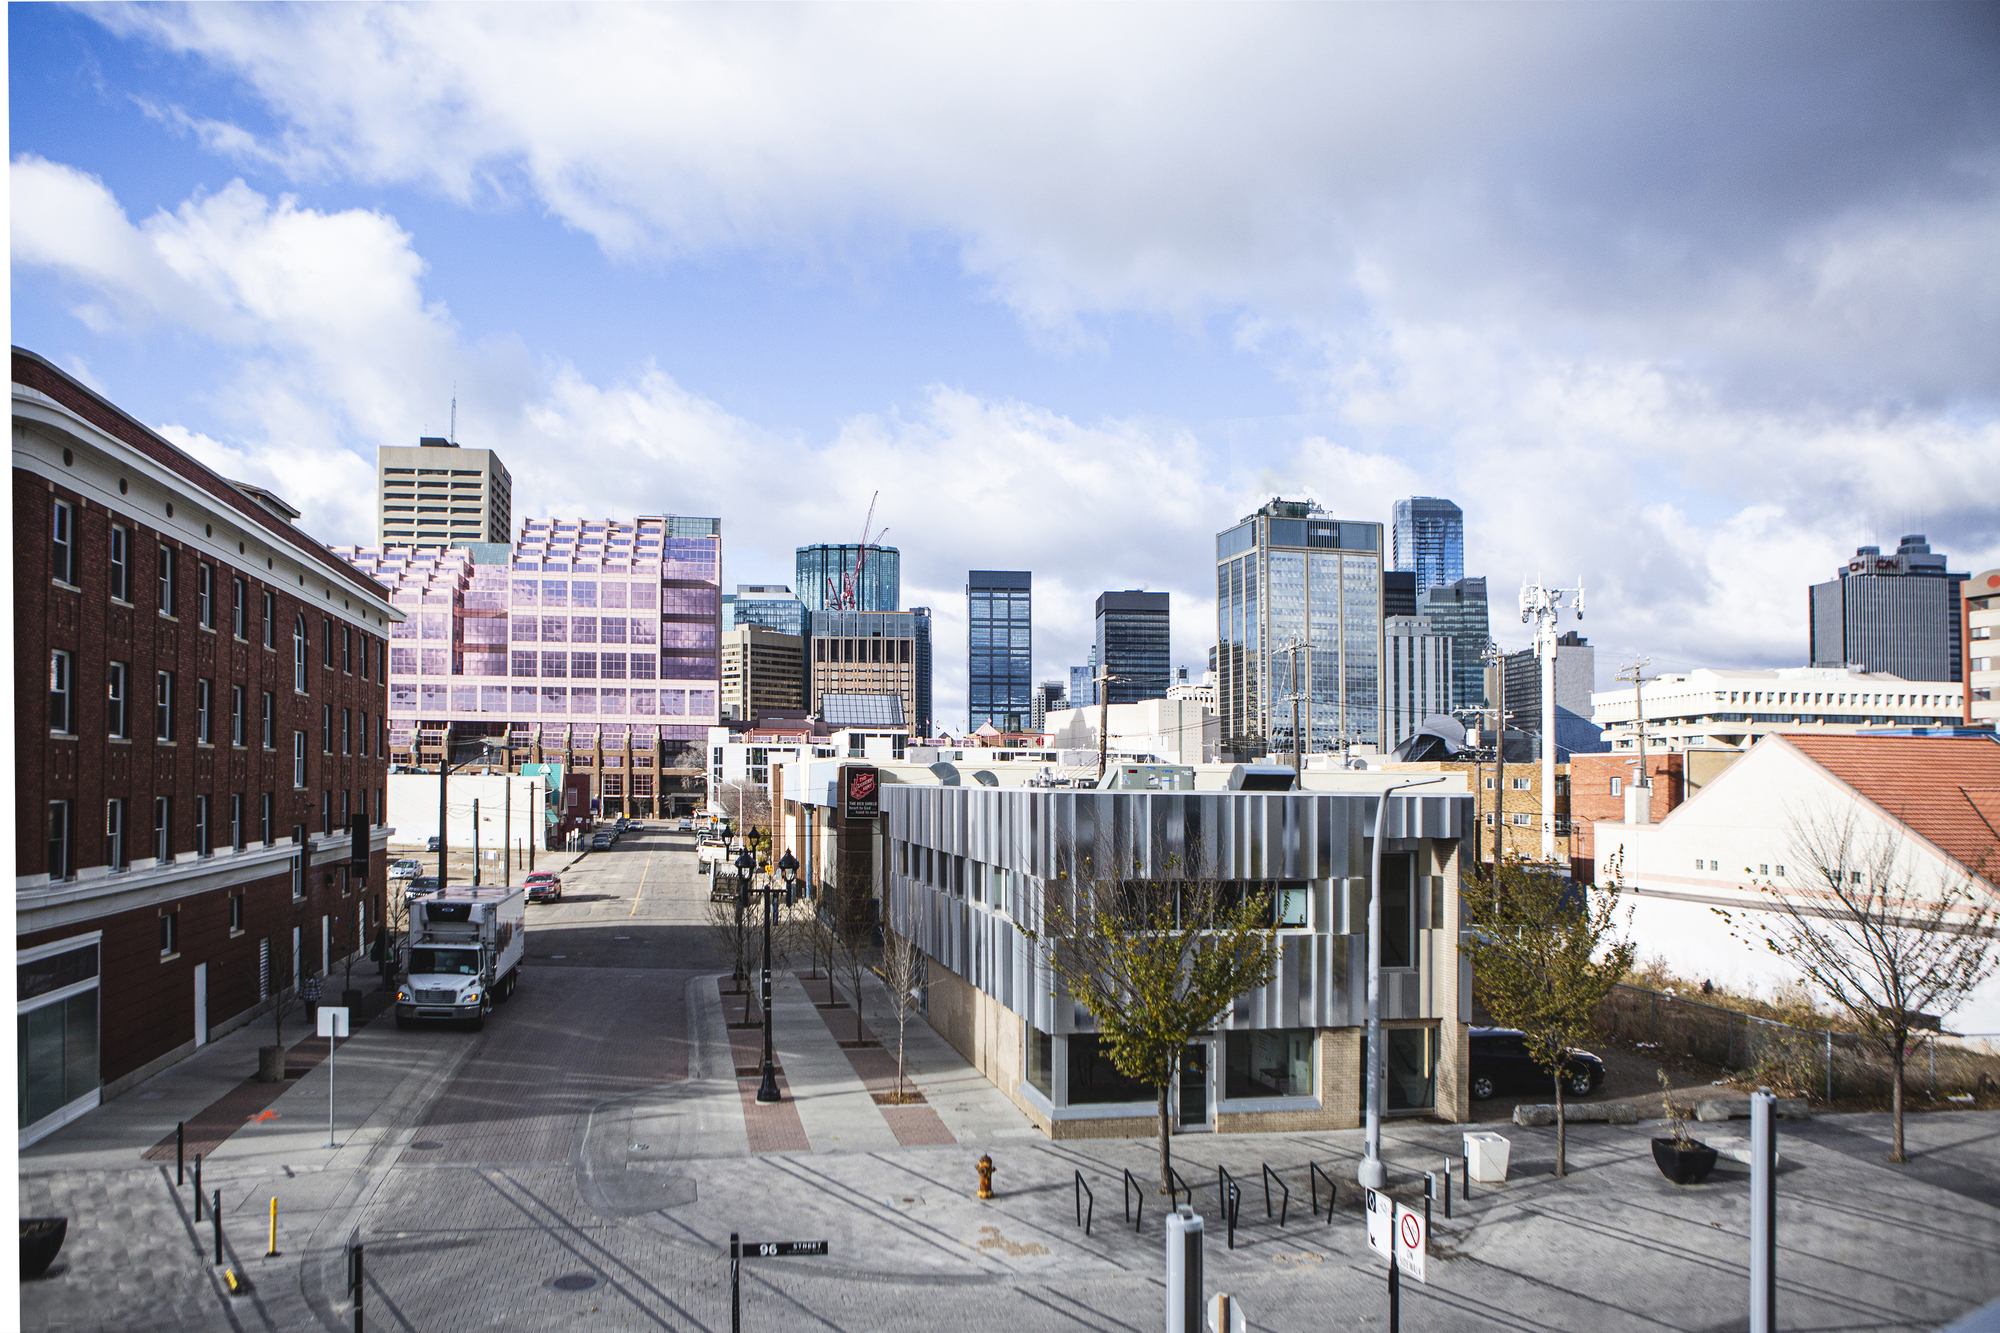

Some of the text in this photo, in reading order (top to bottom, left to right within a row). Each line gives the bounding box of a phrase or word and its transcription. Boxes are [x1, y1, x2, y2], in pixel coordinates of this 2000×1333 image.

[1849, 560, 1865, 572] CN
[760, 1243, 778, 1256] 96
[793, 1242, 821, 1250] STREET
